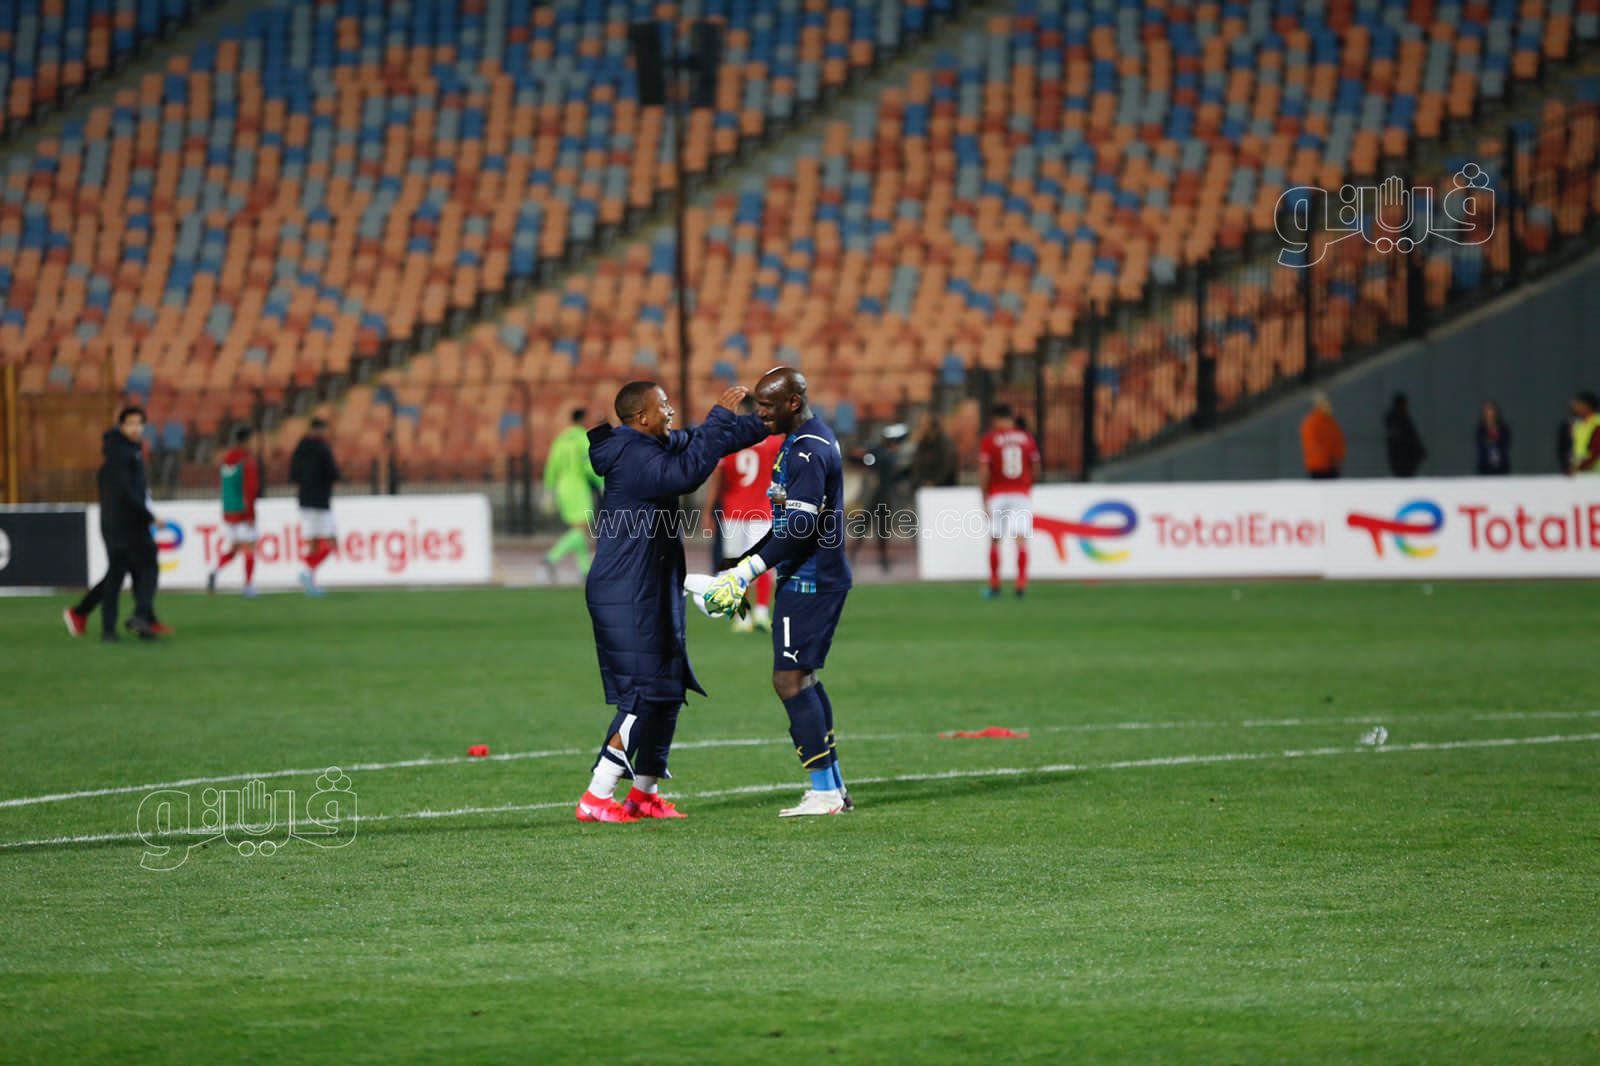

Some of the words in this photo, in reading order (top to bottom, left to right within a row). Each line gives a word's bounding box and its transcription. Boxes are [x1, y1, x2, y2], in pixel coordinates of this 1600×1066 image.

[736, 448, 760, 488] 9
[195, 516, 466, 575] Talergies
[783, 617, 790, 647] 1
